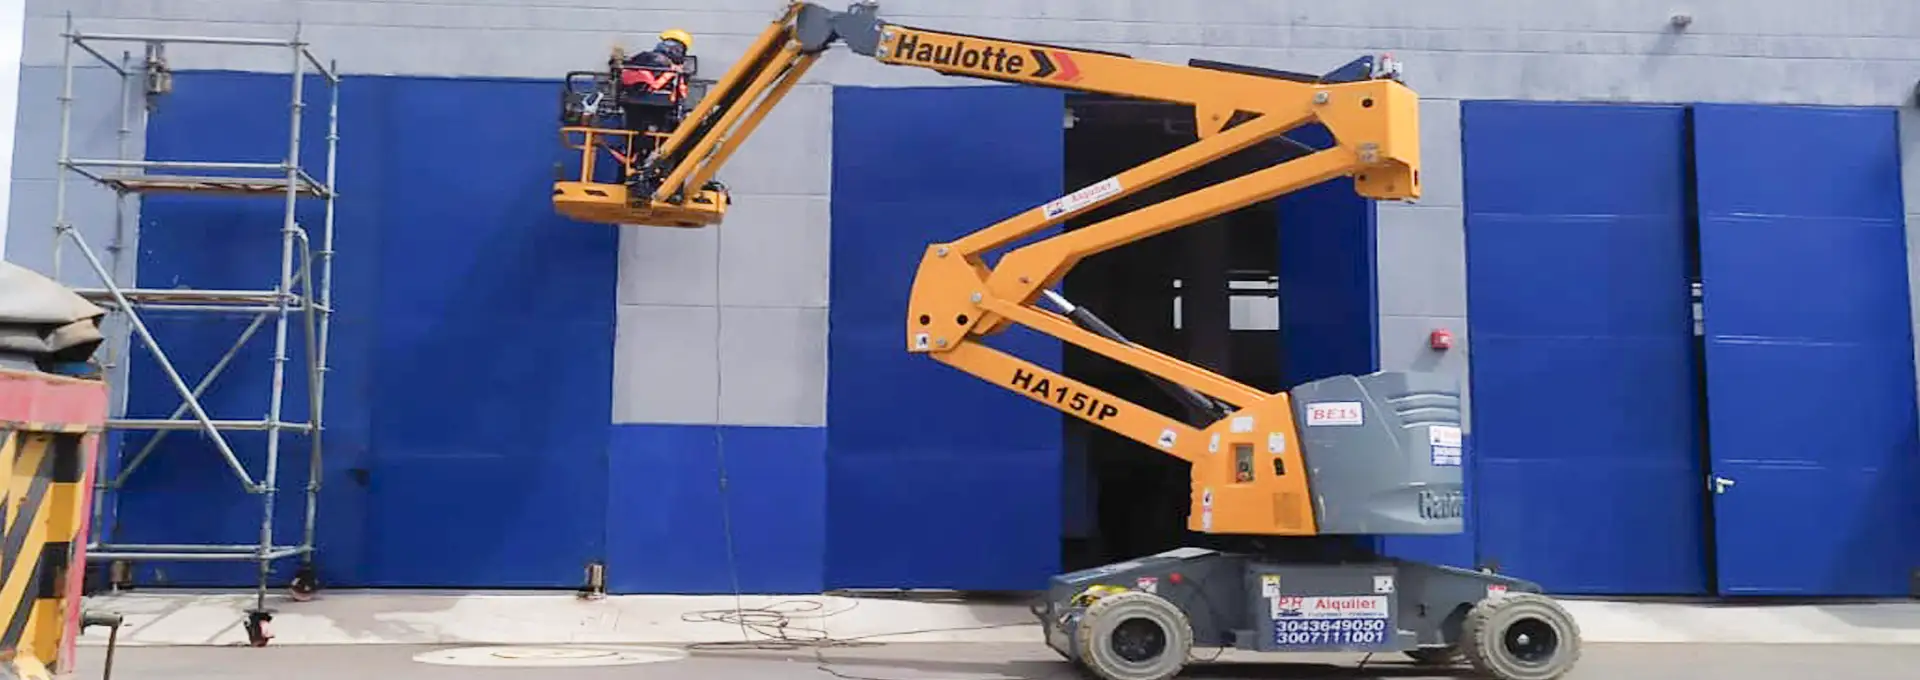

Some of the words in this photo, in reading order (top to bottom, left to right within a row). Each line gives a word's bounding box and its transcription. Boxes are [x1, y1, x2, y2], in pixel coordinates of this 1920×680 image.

[894, 33, 1024, 74] Haulotte
[1011, 368, 1119, 420] HA15IP
[1315, 598, 1377, 611] Alquiler
[1276, 619, 1385, 632] 3043649050
[1276, 631, 1384, 644] 3007111001
